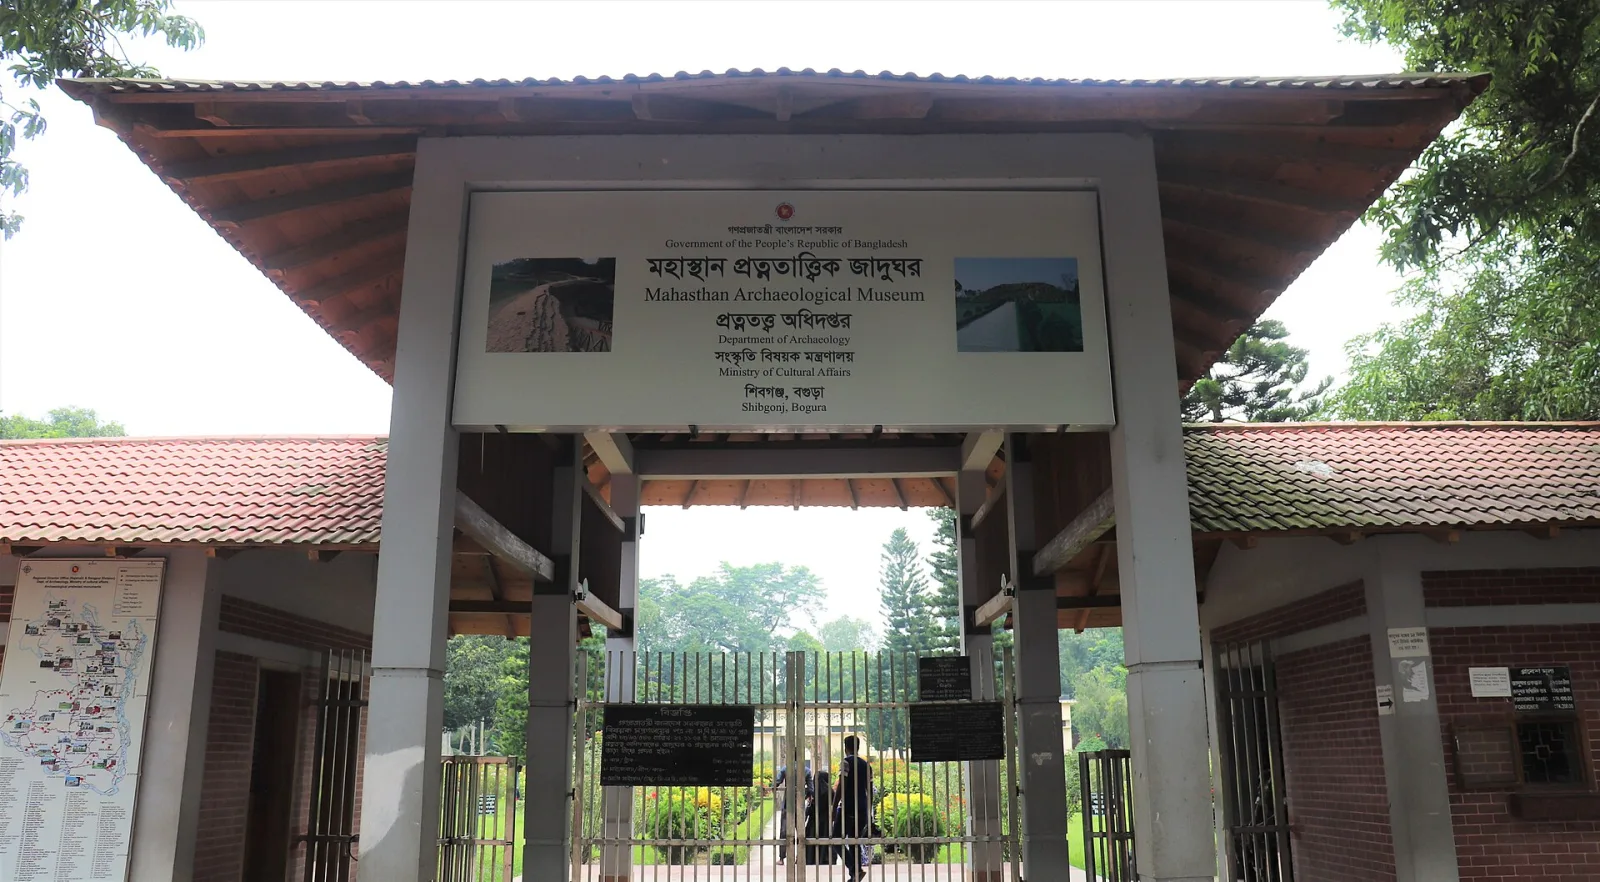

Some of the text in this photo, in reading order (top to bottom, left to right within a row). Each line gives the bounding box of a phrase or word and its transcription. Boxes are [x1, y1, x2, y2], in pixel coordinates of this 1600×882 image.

[728, 225, 843, 236] গণপ্রজাতন্ত্রী বাংলাদেশ সরকার
[666, 239, 723, 248] Government
[726, 239, 737, 248] of
[738, 239, 753, 248] the
[798, 239, 839, 250] Republic
[842, 239, 853, 248] of
[855, 239, 908, 250] Bangladesh
[646, 252, 924, 283] মহাস্থান প্রত্নতাত্ত্বিক জাদুঘর
[644, 287, 926, 304] Mahasthan Archaeological Museum
[716, 308, 853, 333] প্রত্নতত্ত্ব অধিদপ্তর
[719, 335, 851, 346] Department of Archaeology
[714, 348, 856, 367] সংস্কৃতি বিষয়ক মন্ত্রণালয়
[719, 367, 852, 379] Ministry of Cultural Affairs
[744, 383, 826, 401] শিবগঞ্জ, বগুড়া
[742, 402, 828, 414] Shibgonj, Bogura
